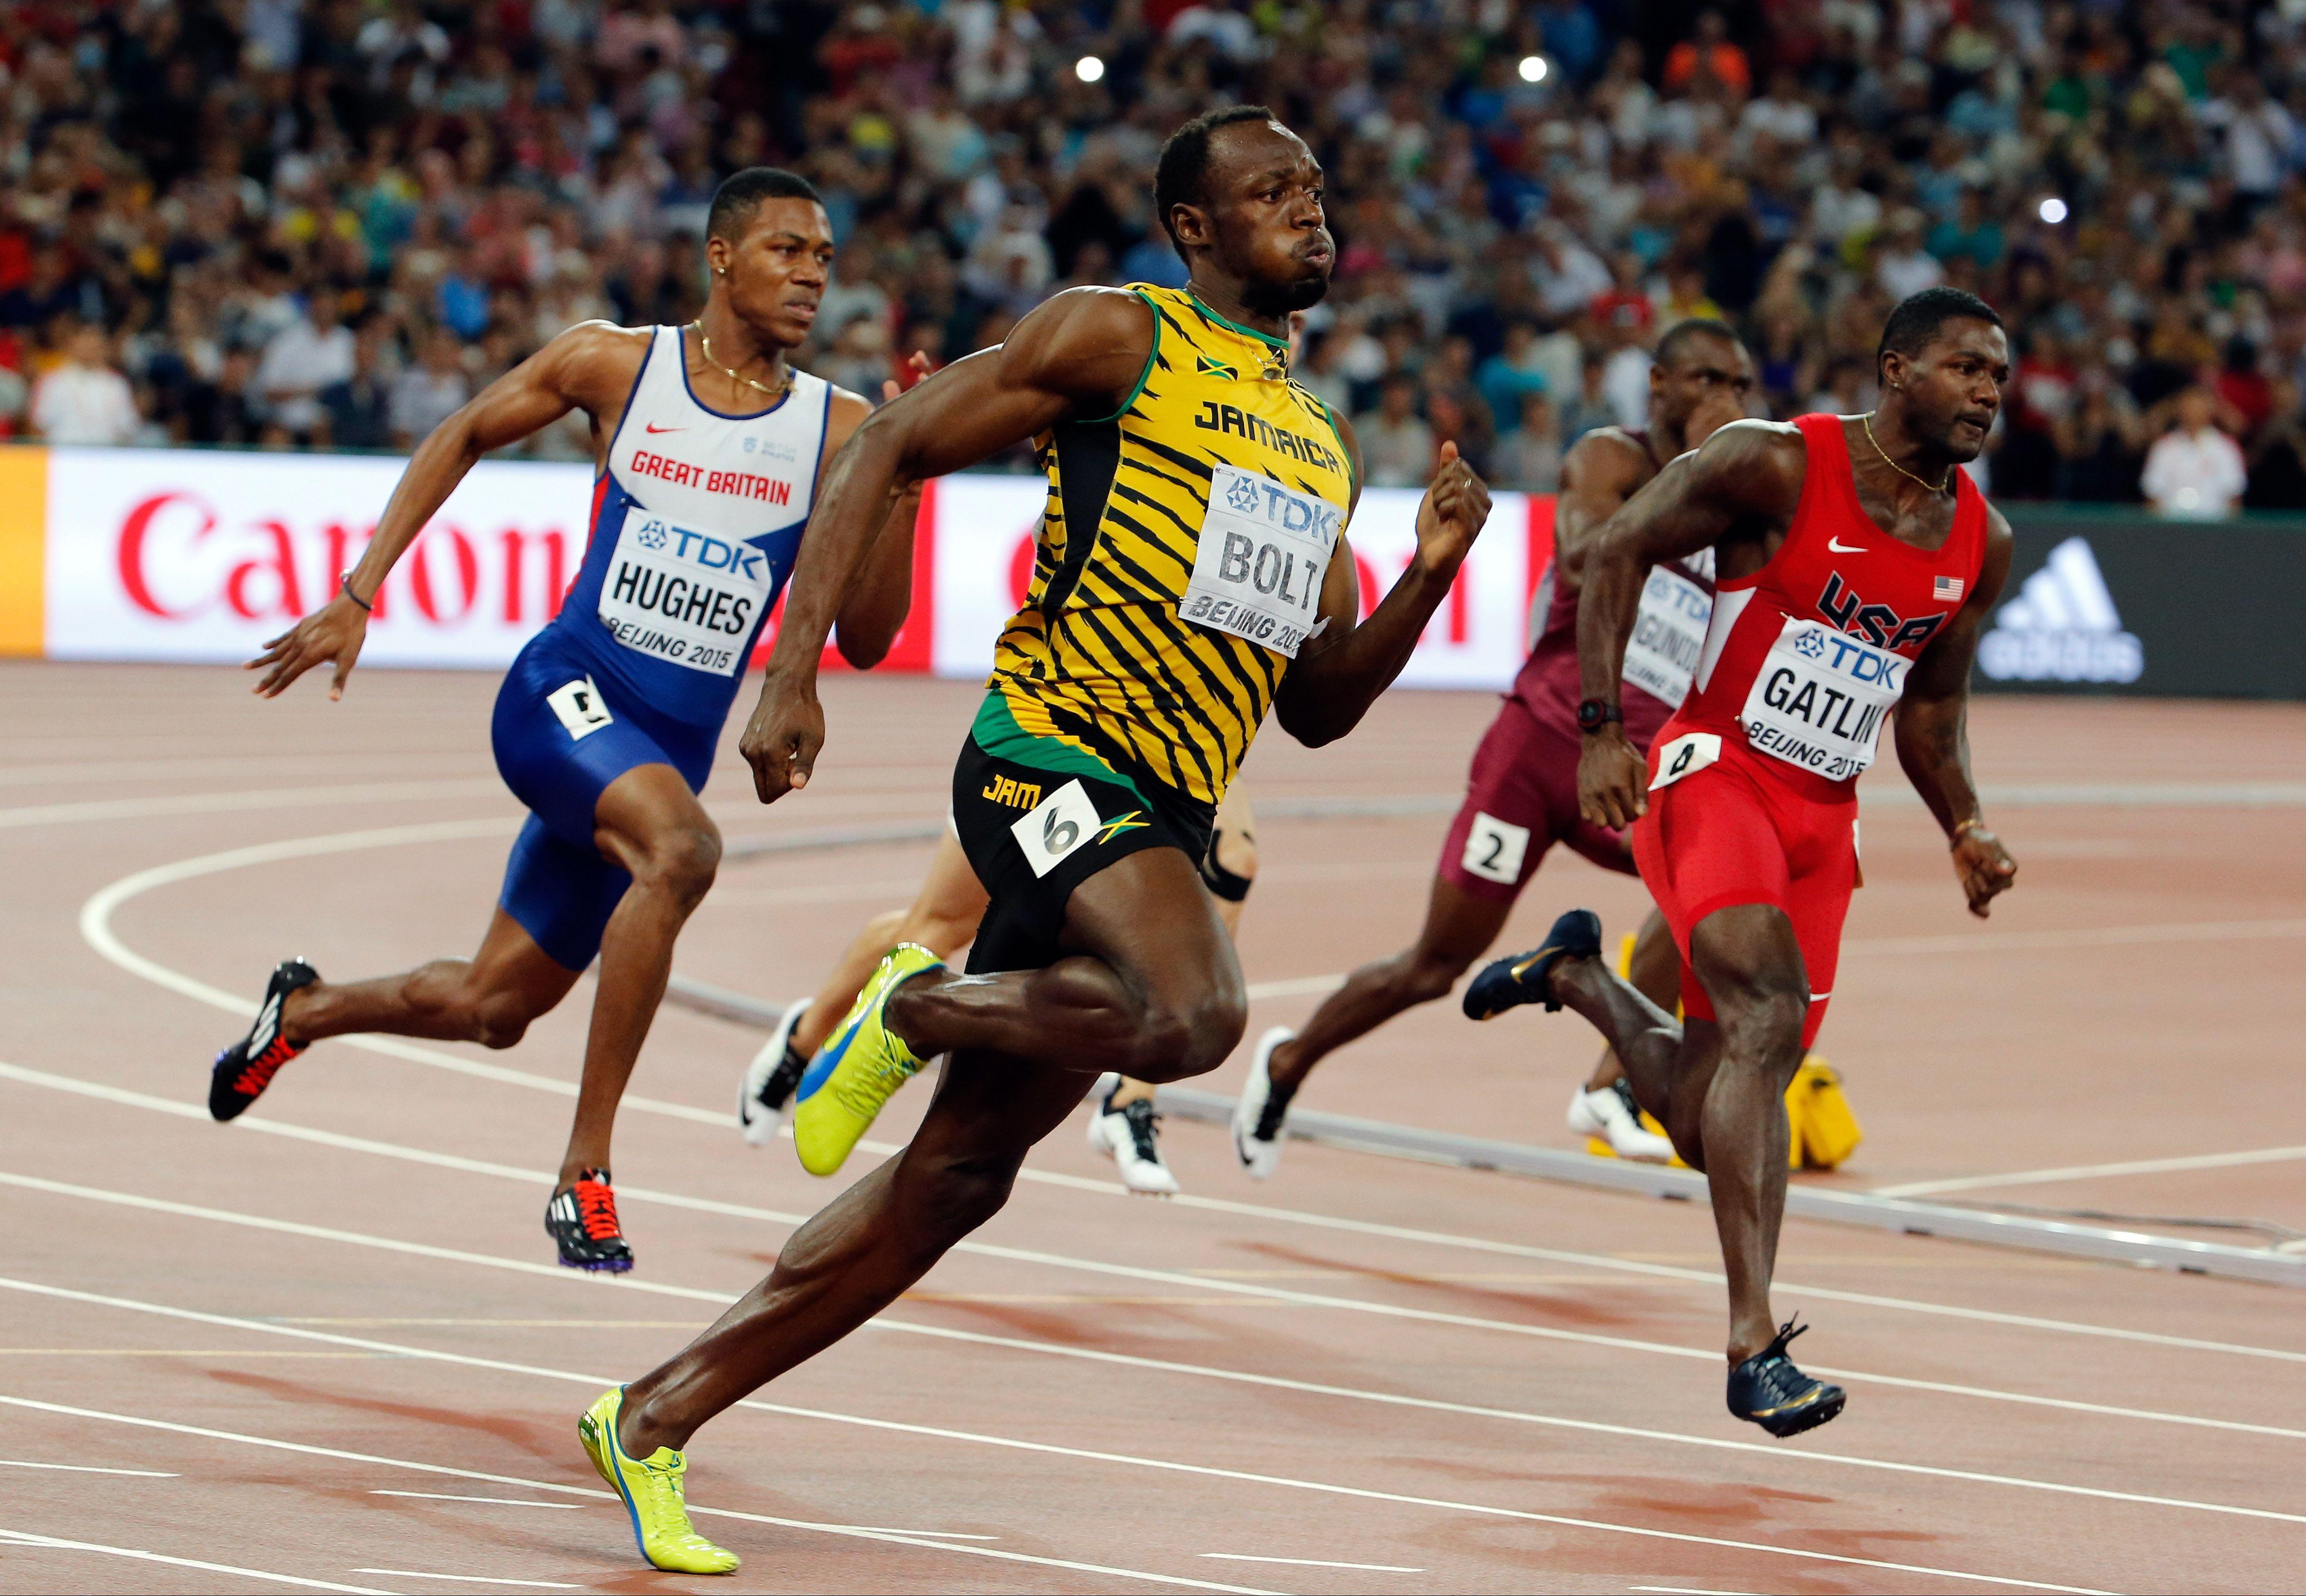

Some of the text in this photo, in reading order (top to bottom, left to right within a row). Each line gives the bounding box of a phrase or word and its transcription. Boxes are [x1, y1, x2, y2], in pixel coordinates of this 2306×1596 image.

[1194, 401, 1342, 478] JAMAICA
[631, 451, 791, 507] GREAT BRITAIN
[1261, 482, 1336, 546] TDK
[671, 526, 765, 581] TDK
[1219, 531, 1318, 611] BOLT
[612, 561, 751, 635] HUGHES
[1188, 595, 1276, 639] BEIJING
[1674, 583, 1711, 625] TD
[1815, 569, 1948, 651] USA
[608, 617, 734, 669] BEIJING 2015
[1830, 636, 1901, 690] TDK
[1764, 667, 1884, 744] GATLIN
[1749, 721, 1827, 766] BEIJING
[982, 774, 1042, 810] JAM
[1043, 805, 1079, 855] 6
[1481, 832, 1503, 870] 2
